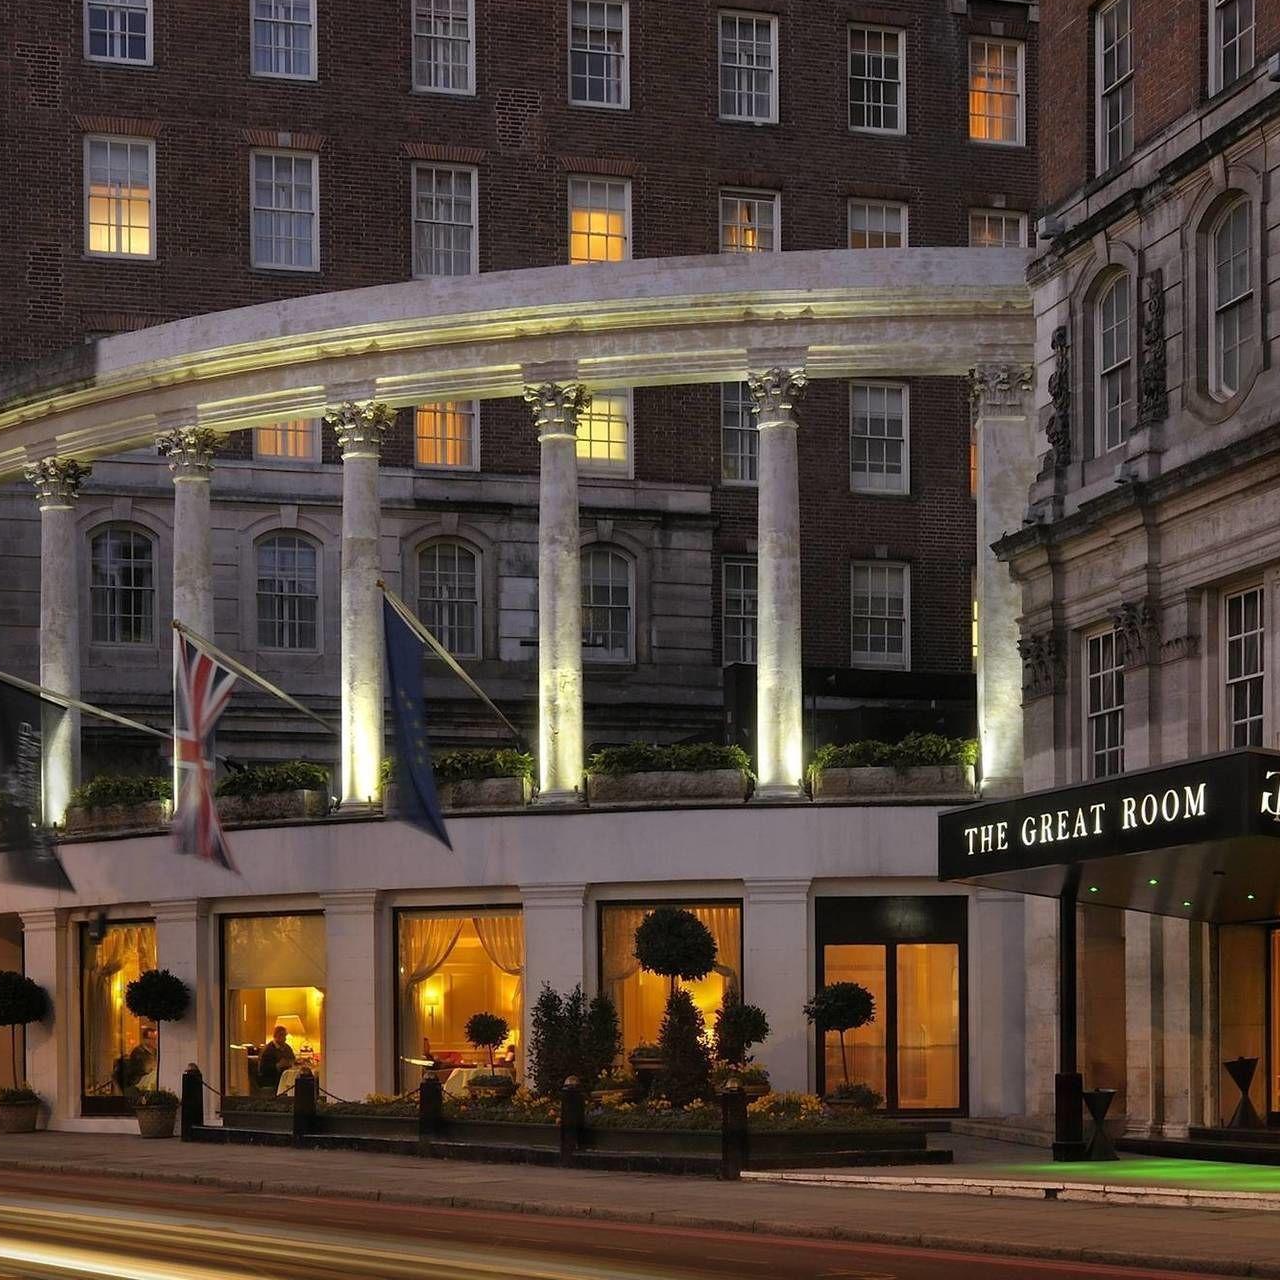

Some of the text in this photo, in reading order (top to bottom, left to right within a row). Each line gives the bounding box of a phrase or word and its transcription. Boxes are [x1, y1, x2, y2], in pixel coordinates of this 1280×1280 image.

[964, 783, 1206, 855] THE GREAT ROOM
